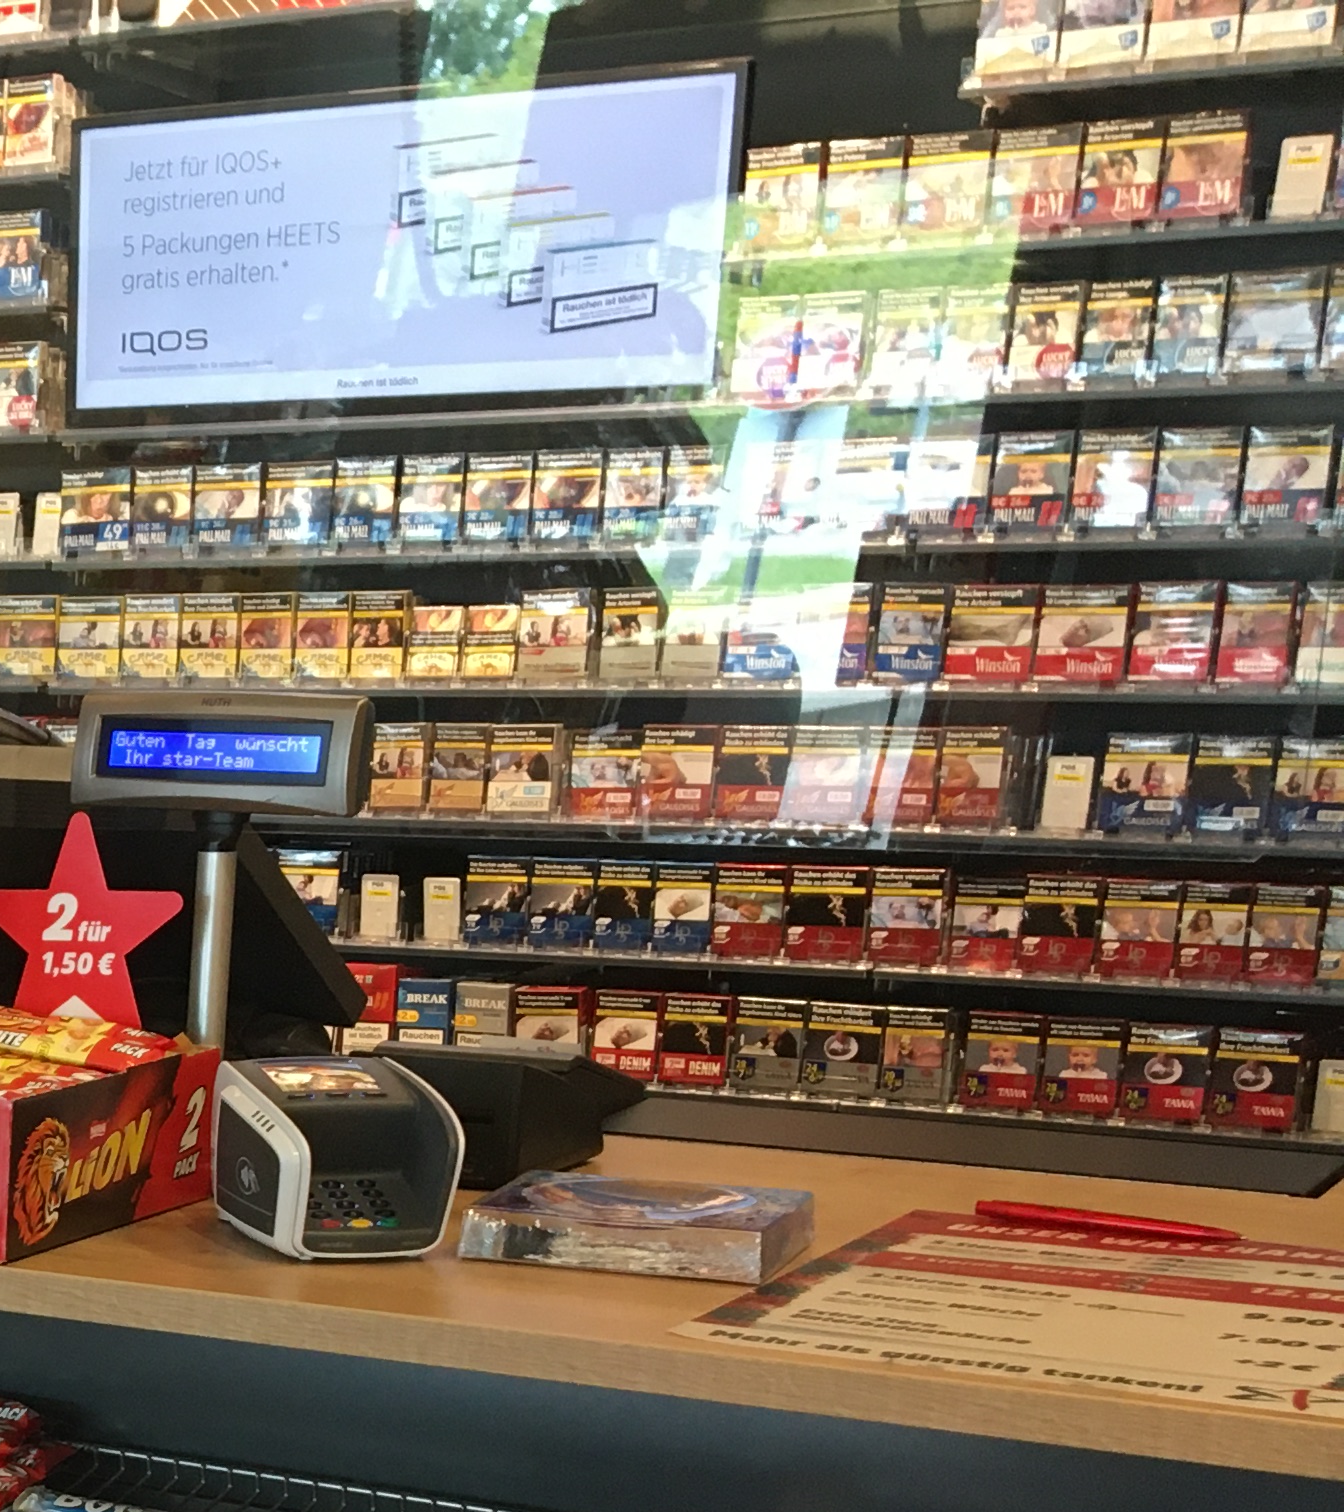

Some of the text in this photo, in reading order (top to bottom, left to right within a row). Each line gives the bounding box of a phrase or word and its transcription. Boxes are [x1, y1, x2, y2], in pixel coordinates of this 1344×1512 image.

[124, 149, 282, 182] Jetzt für IQOS+
[124, 182, 285, 216] registrieren und
[123, 221, 341, 258] 5 Packungen HEETS
[122, 267, 179, 294] gratis
[121, 328, 208, 356] IQOS
[336, 378, 374, 390] Rauen
[976, 657, 1021, 674] Winston
[115, 733, 309, 752] Guten Tag wünscht
[124, 750, 254, 769] Ihr star-Team
[41, 892, 112, 943] 2 für
[41, 951, 116, 977] 1,50 €
[406, 993, 448, 1006] BREAK
[463, 998, 506, 1011] BREAK
[401, 1030, 441, 1042] Rauchen
[619, 1056, 652, 1073] DENIM
[687, 1060, 722, 1078] DENIM
[997, 1088, 1028, 1100] TAWA
[1078, 1092, 1109, 1104] TAWA
[178, 1086, 207, 1153] 2
[172, 1150, 201, 1180] PACK
[708, 1329, 808, 1347] Mehr
[815, 1342, 872, 1355] als
[879, 1350, 1032, 1374] günstig
